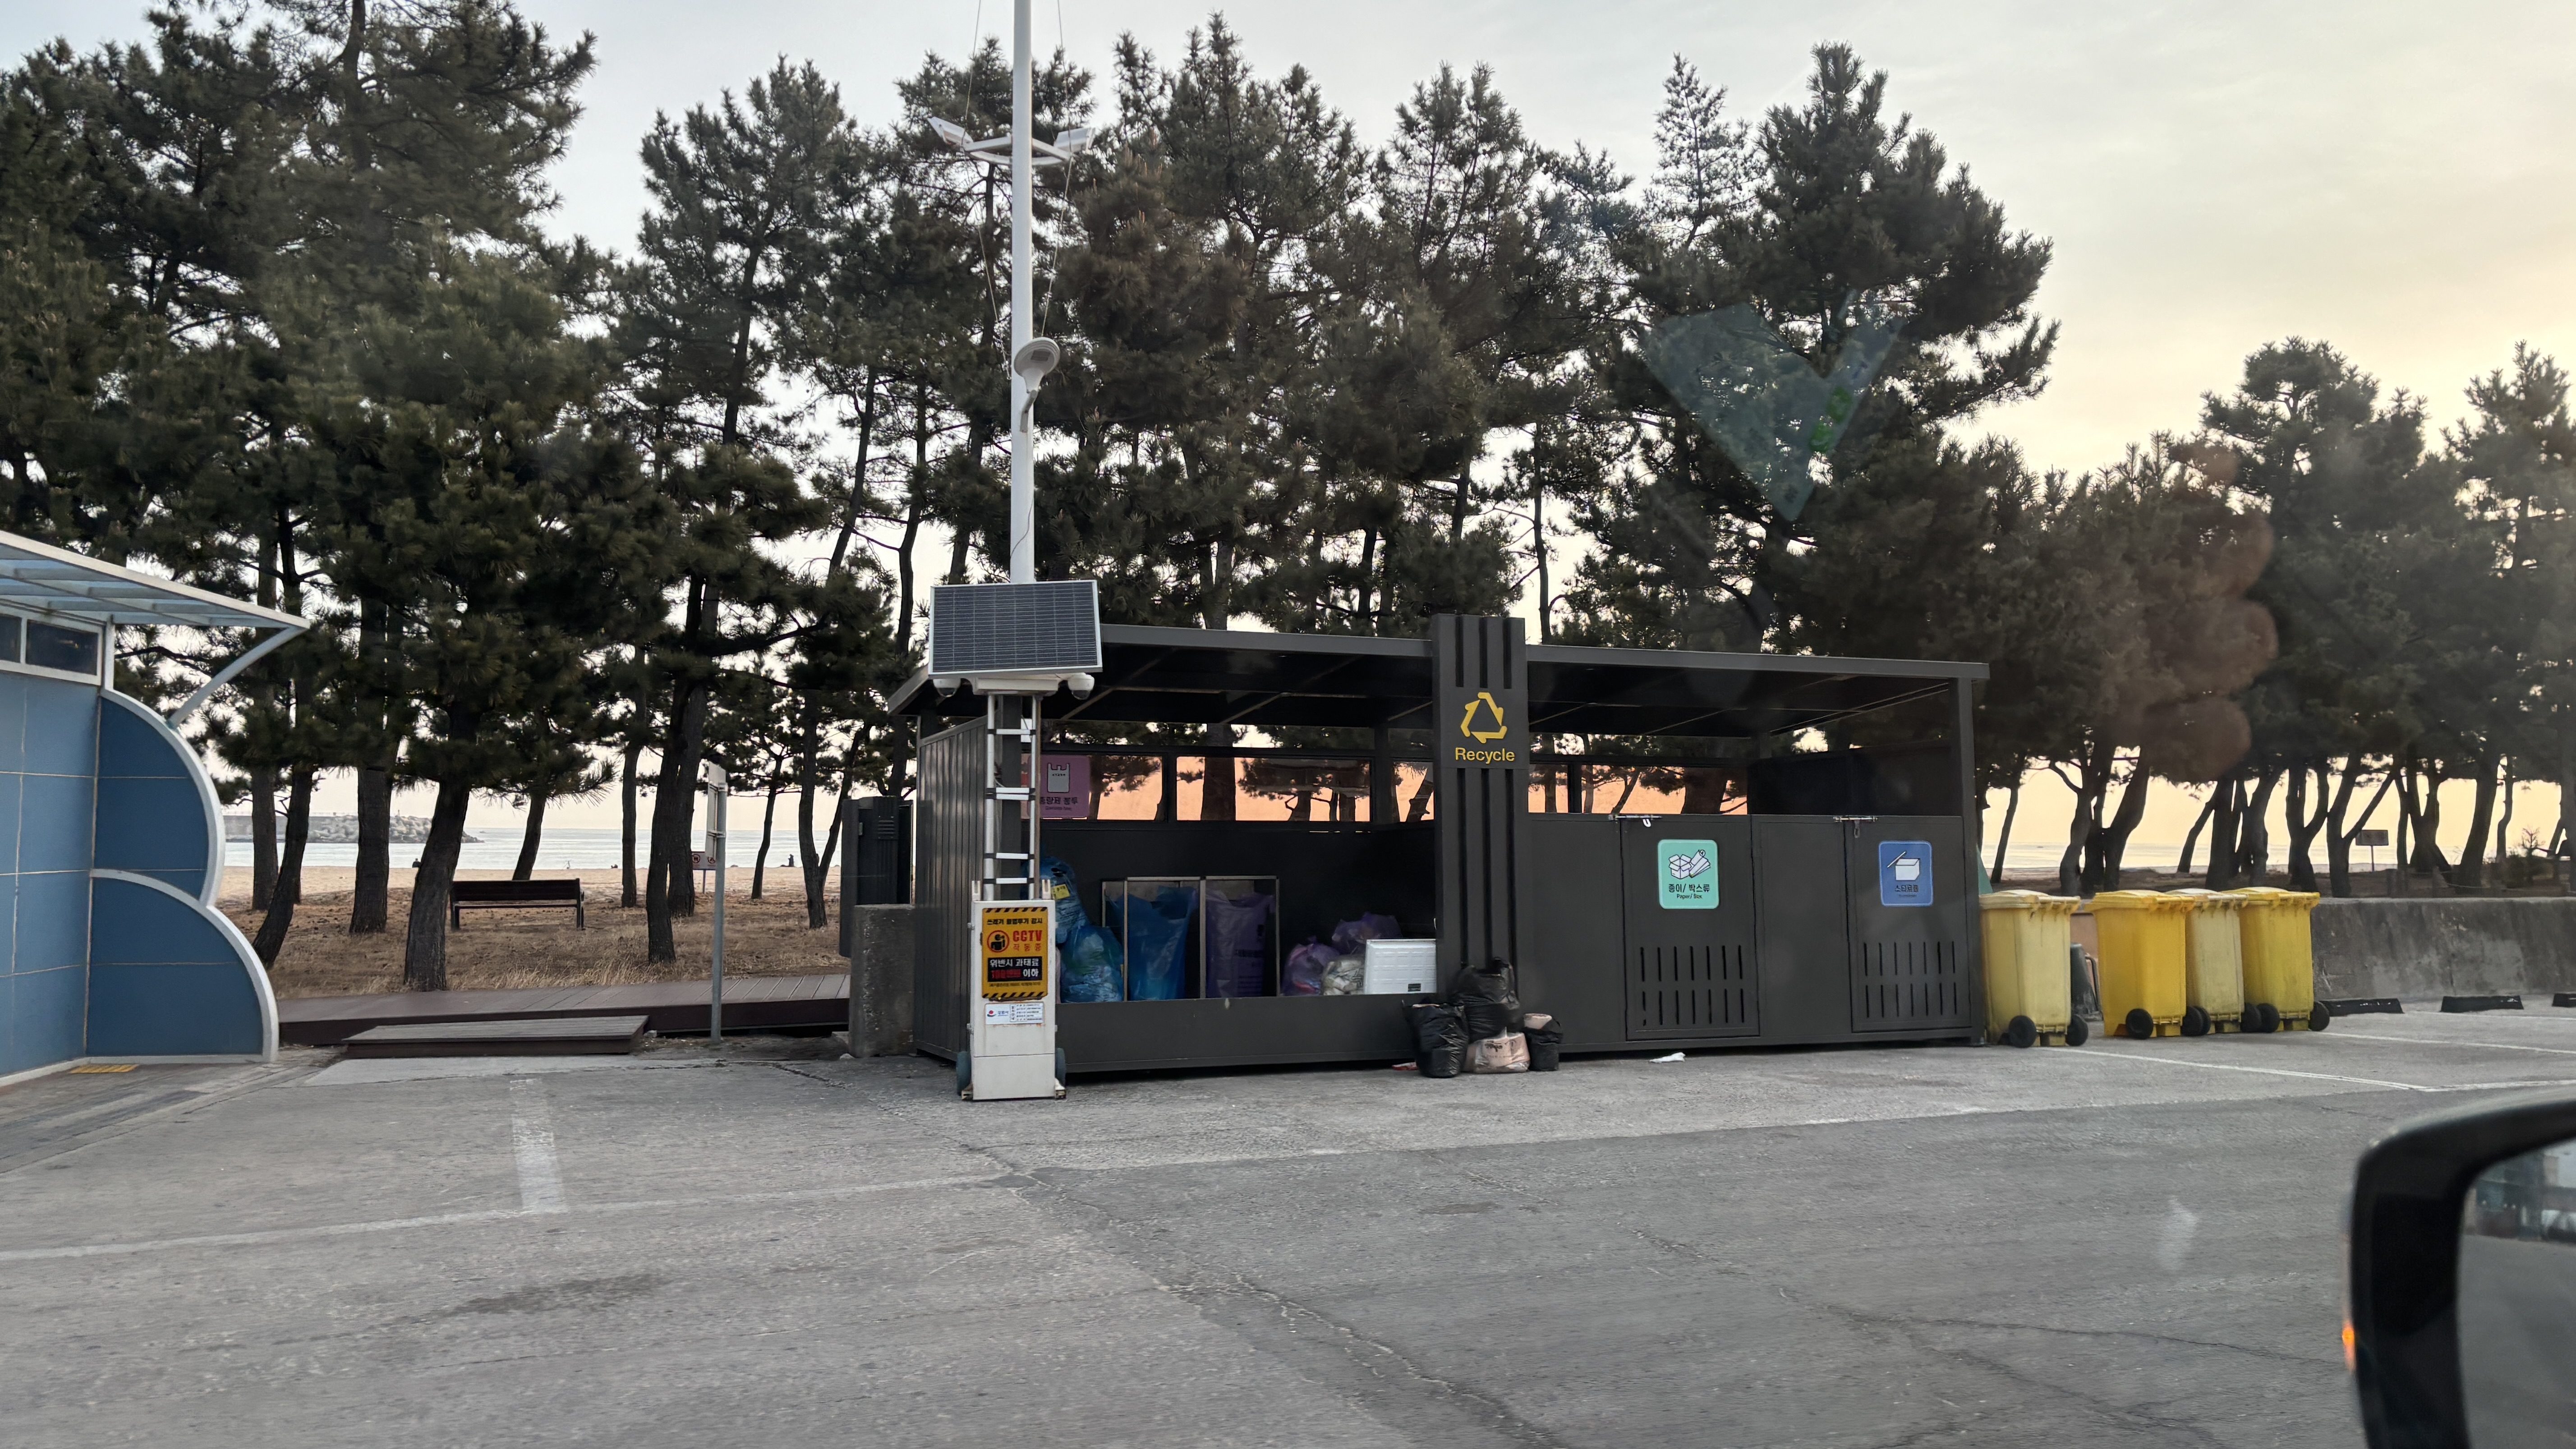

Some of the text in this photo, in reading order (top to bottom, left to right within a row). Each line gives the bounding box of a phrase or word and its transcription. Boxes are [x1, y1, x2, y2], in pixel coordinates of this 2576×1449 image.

[1455, 747, 1516, 764] Recycle
[1689, 884, 1710, 892] 박스류
[1012, 930, 1043, 942] CCTV
[989, 958, 1040, 967] 위반시 과태료
[1023, 969, 1039, 977] 이하
